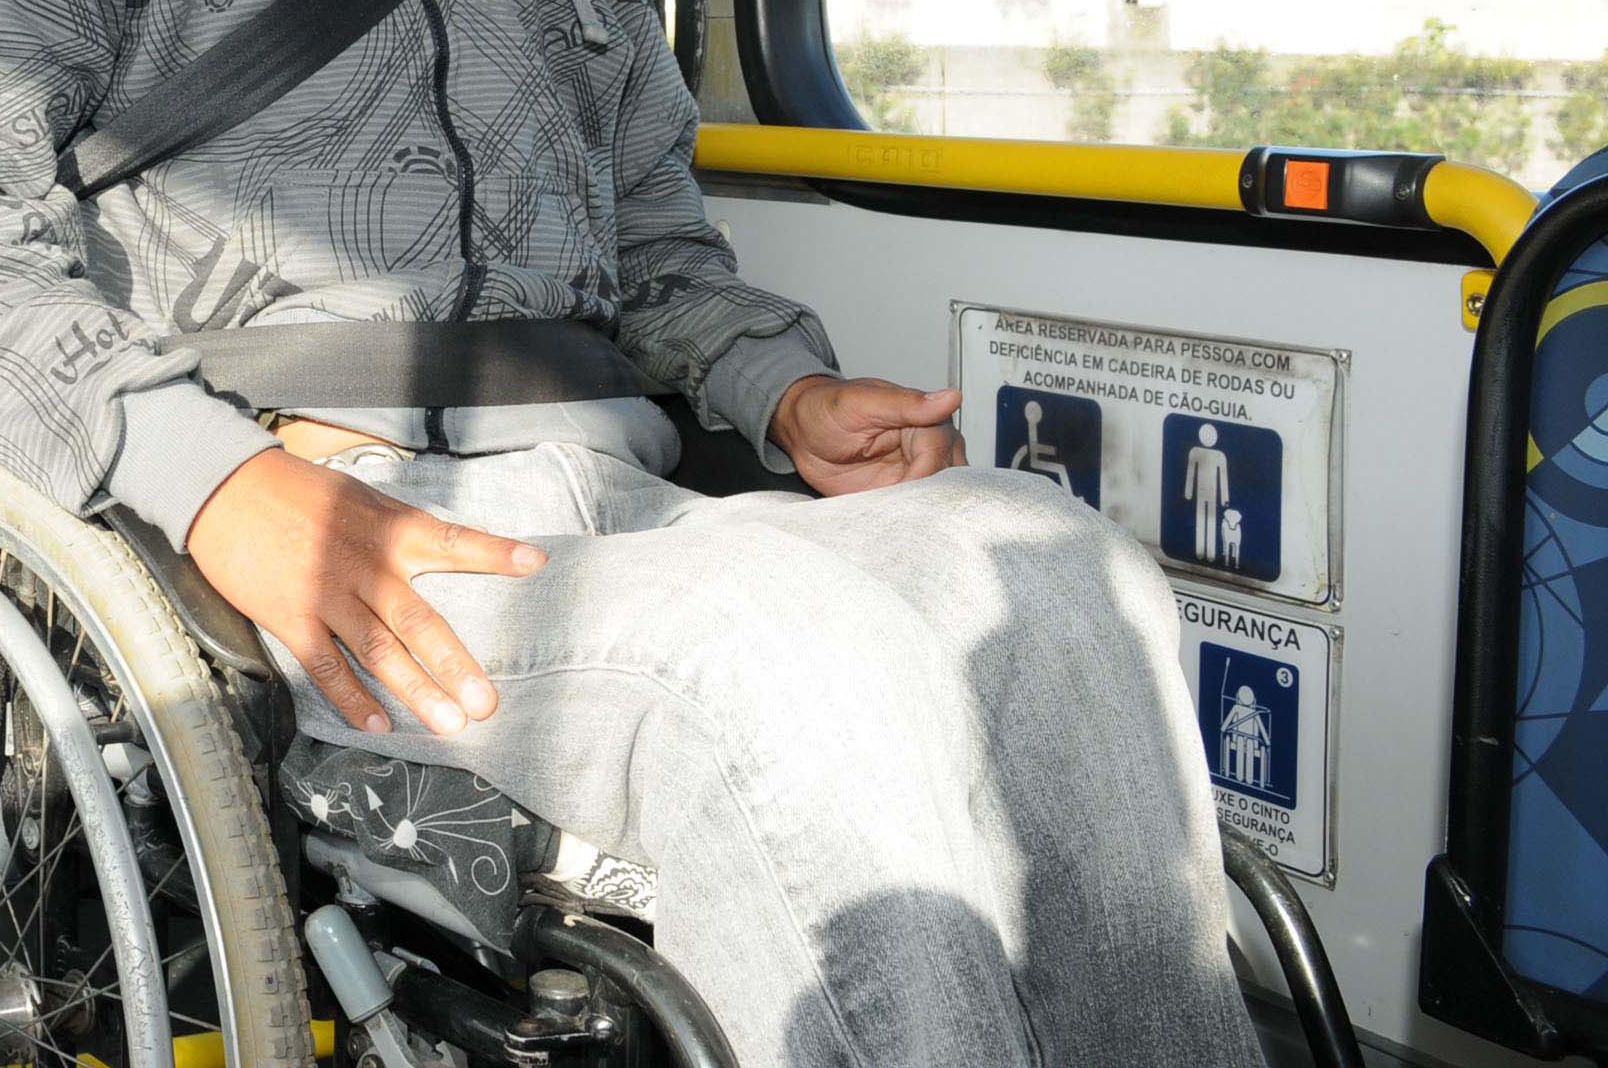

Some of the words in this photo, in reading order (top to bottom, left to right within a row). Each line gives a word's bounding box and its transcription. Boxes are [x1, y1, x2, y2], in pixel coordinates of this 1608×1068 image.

[1038, 322, 1130, 350] RESERVADA
[1133, 337, 1177, 356] PARA
[1180, 342, 1247, 367] PESSOA
[1251, 352, 1291, 372] COM
[989, 340, 1078, 367] DEFICIÊNCIA
[1082, 354, 1104, 371] EM
[1108, 359, 1177, 382] CADEIRA
[1181, 368, 1202, 386] DE
[1207, 372, 1266, 396] RODAS
[1270, 381, 1296, 400] OU
[1023, 370, 1139, 403] ACOMPANHADA
[1143, 389, 1164, 406] DE
[1169, 391, 1253, 421] CÃO-GUIA.
[1280, 670, 1290, 684] 3
[1217, 807, 1296, 845] SEGURANÇA
[1238, 797, 1248, 811] O
[1251, 801, 1291, 825] CINTO
